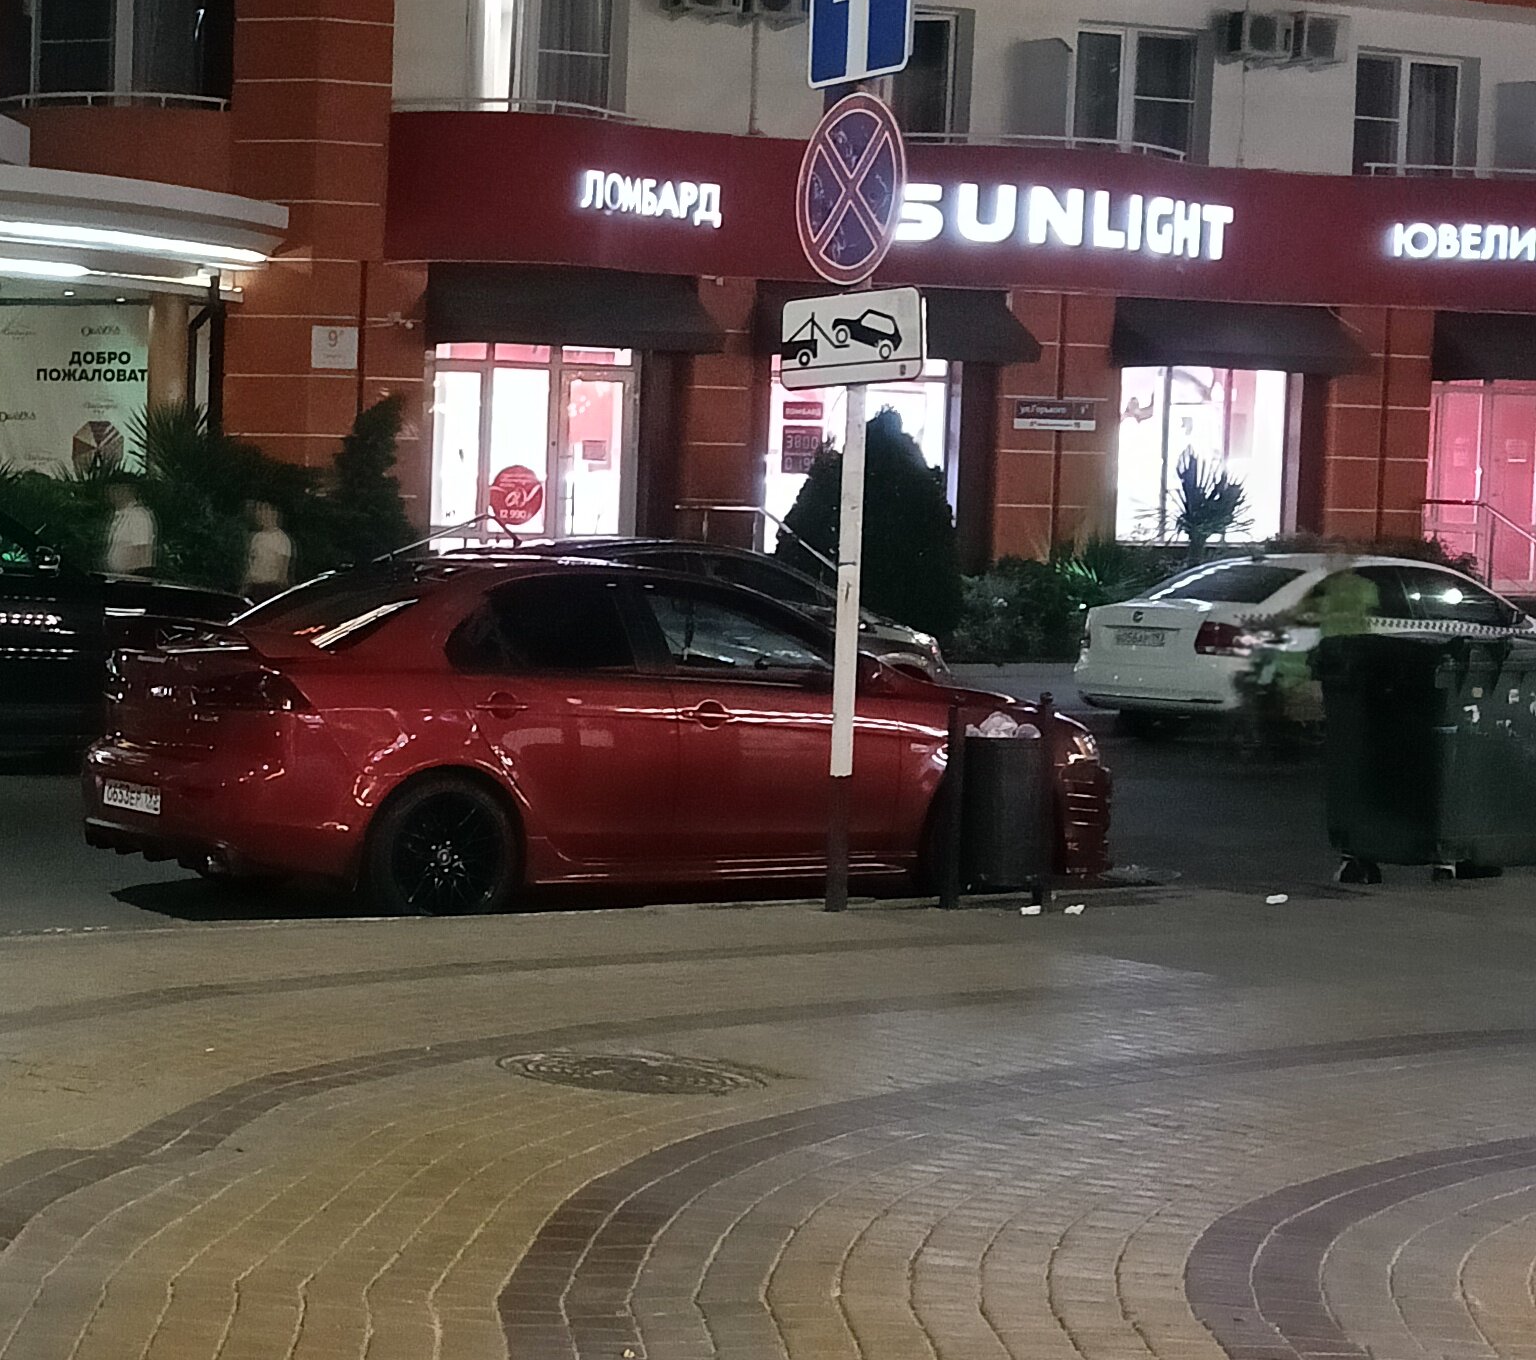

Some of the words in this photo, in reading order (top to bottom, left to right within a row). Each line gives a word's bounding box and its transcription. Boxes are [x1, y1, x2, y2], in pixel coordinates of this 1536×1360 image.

[580, 169, 722, 229] ЛОМБАРД
[895, 182, 1234, 260] SUNLIGHT
[36, 368, 147, 382] ПОЖАЛОВАТ
[69, 351, 131, 367] ДОБРО
